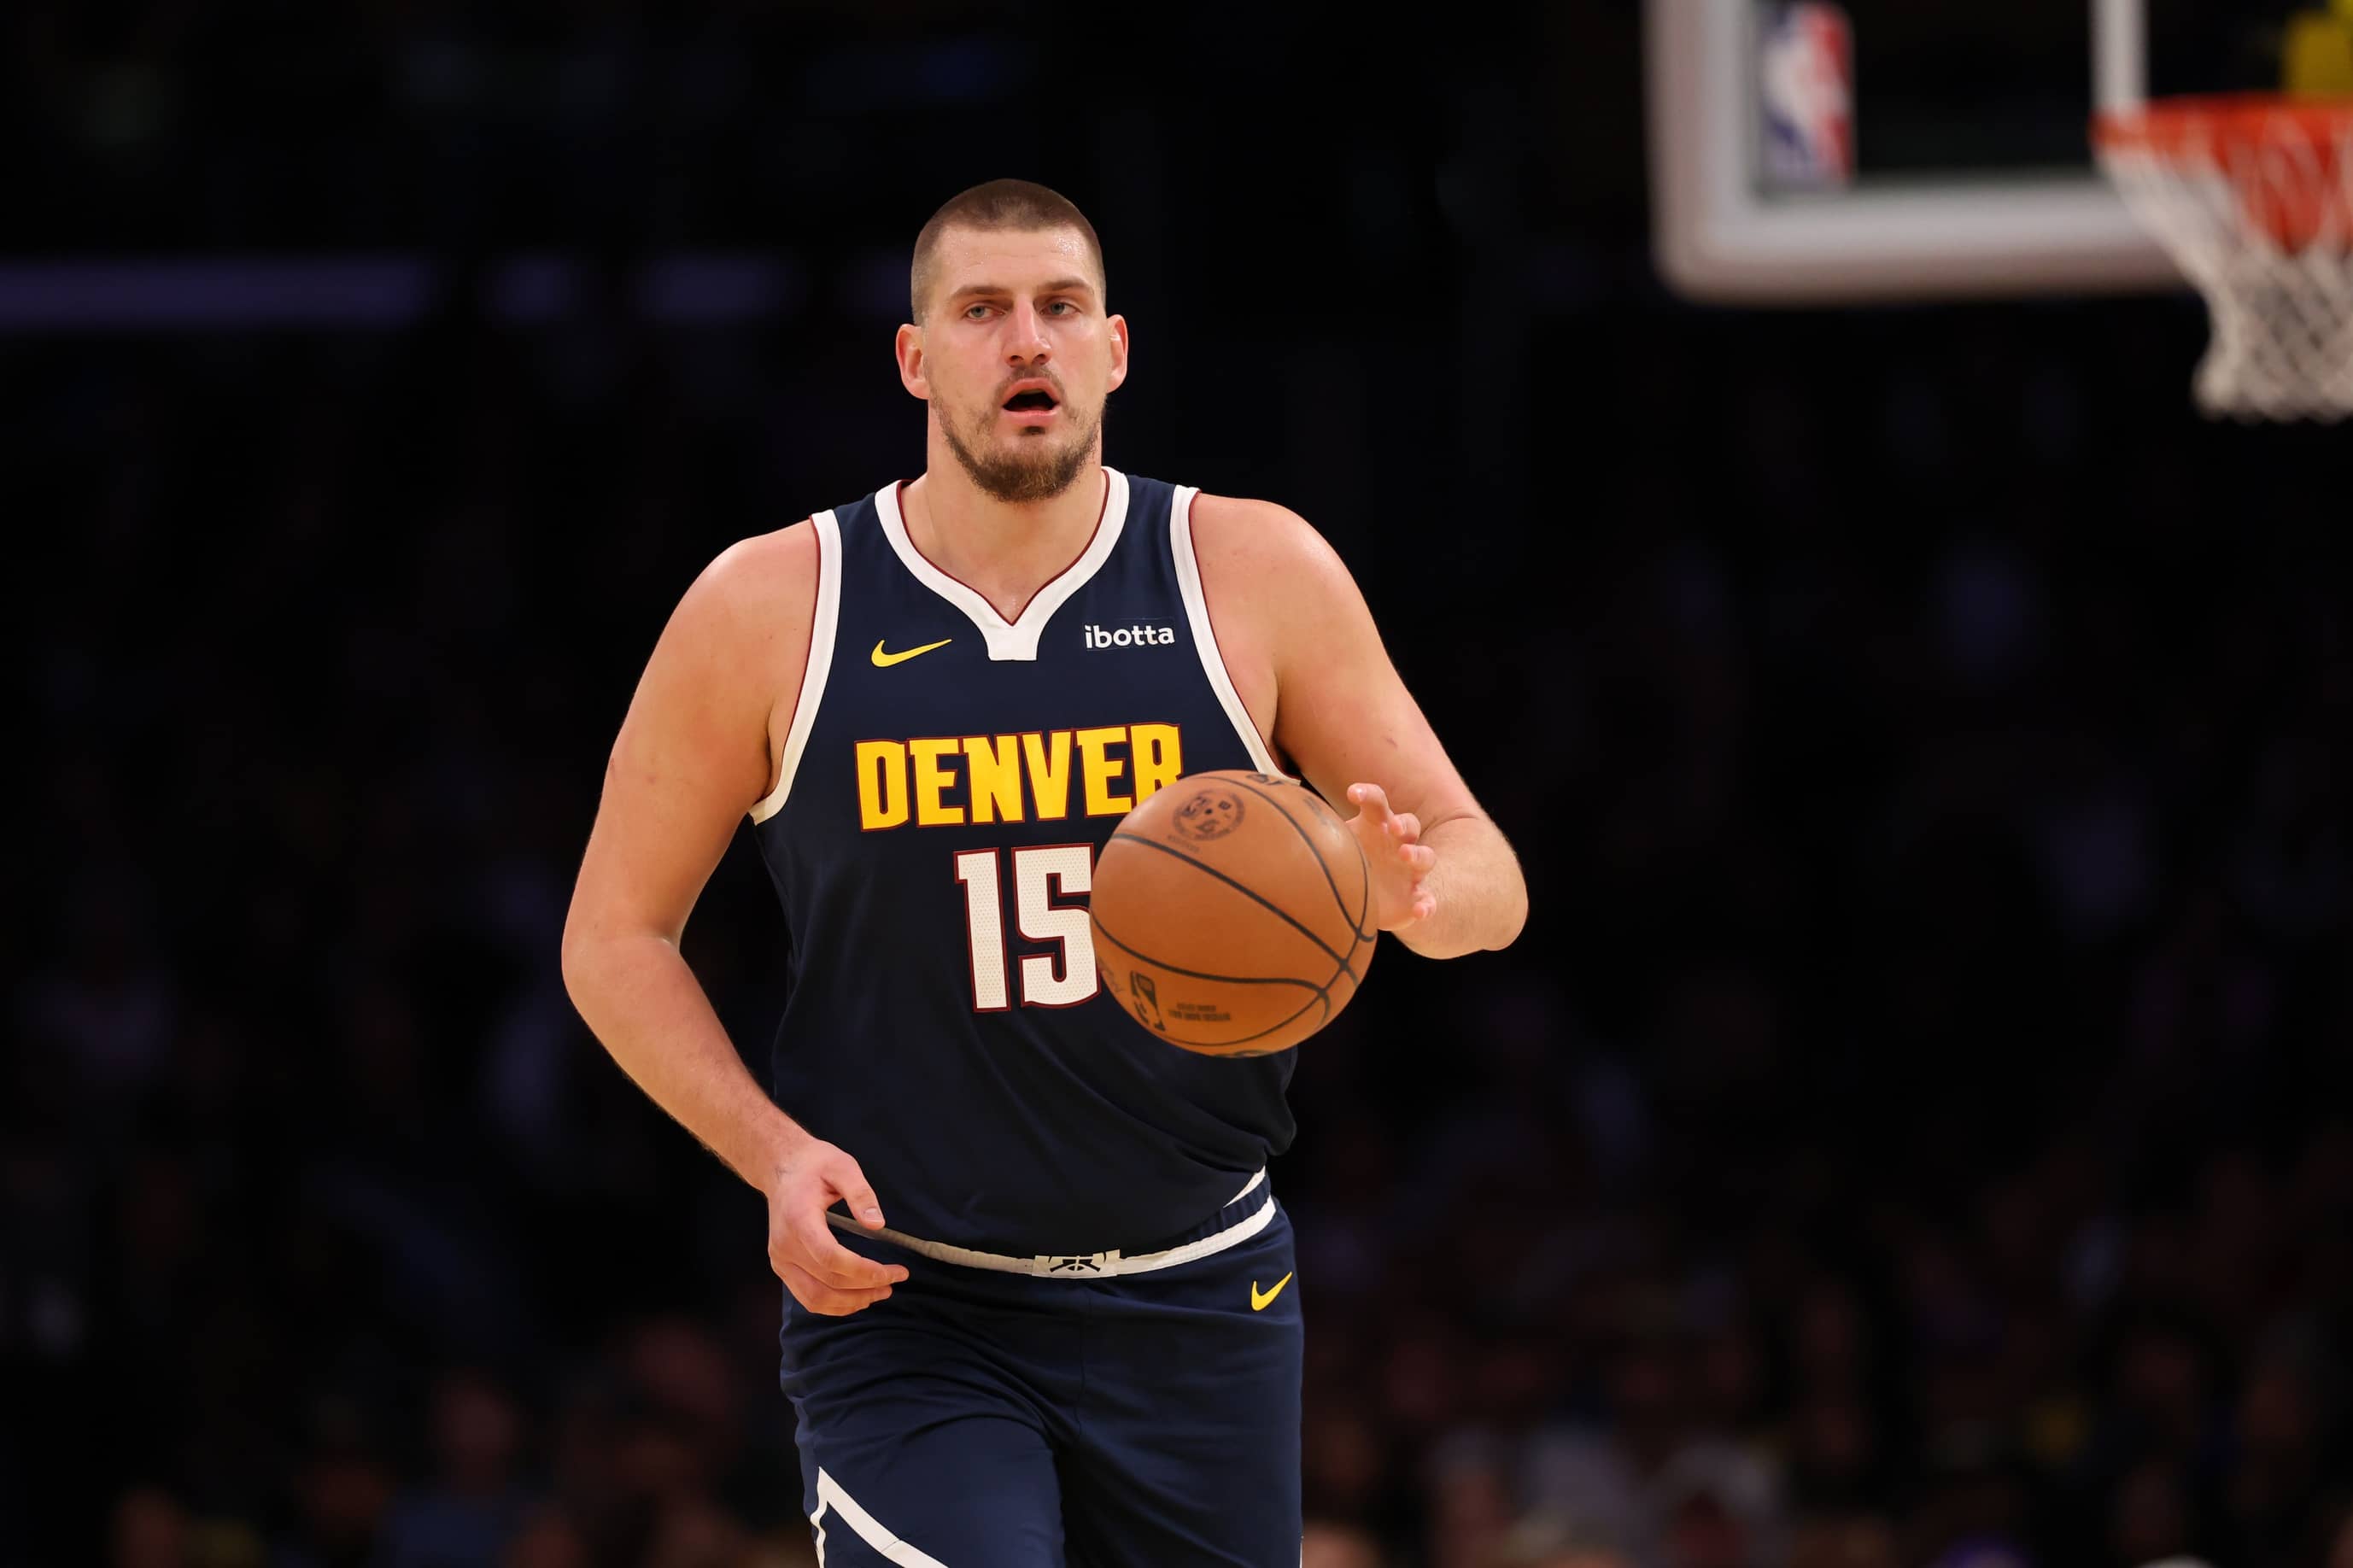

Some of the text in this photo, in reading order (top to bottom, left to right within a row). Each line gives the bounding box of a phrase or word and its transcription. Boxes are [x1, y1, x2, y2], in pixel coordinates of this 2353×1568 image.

[1084, 624, 1175, 649] ibotta
[854, 722, 1185, 832] DENVER
[953, 843, 1102, 1013] 15
